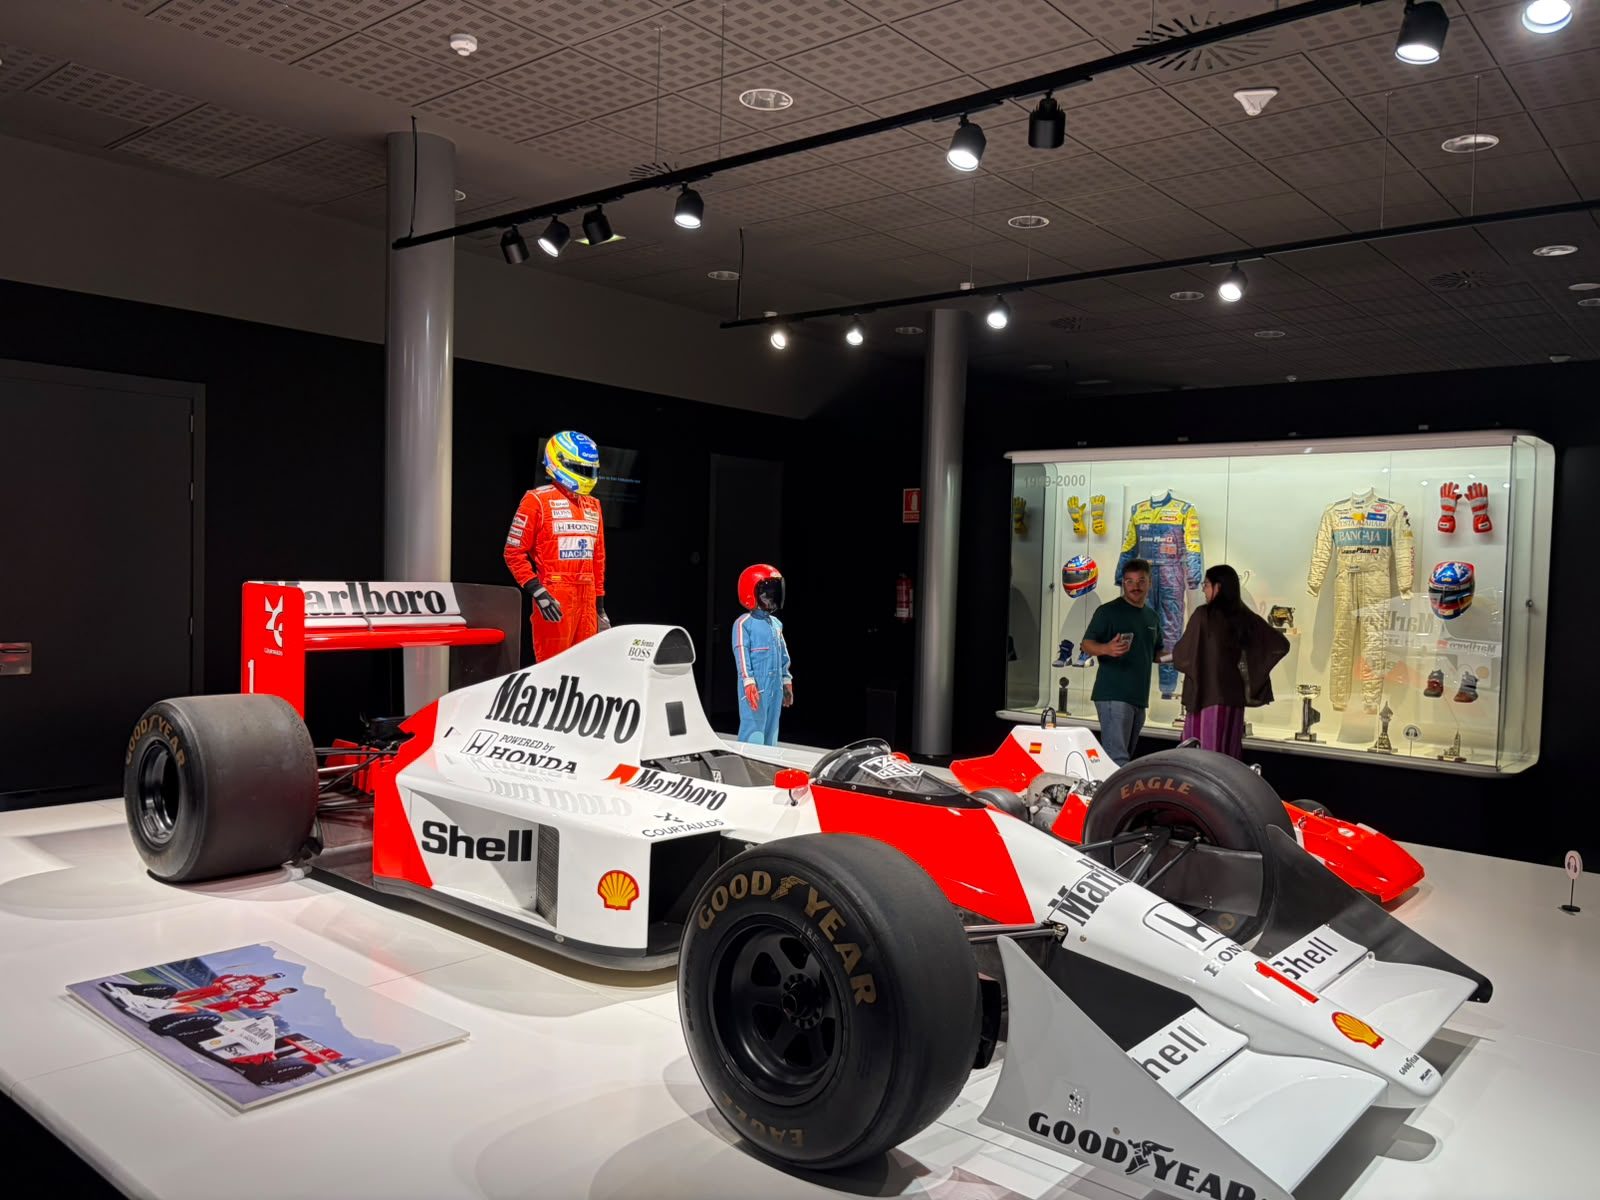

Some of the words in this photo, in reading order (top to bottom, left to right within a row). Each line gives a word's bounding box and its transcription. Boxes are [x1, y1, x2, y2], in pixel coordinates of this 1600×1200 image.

[1339, 529, 1381, 542] BANCAJA
[303, 582, 447, 616] arlboro
[628, 647, 651, 659] BOSS
[485, 672, 641, 745] Marlboro
[486, 745, 578, 775] HONDA
[498, 734, 544, 750] POWERED
[542, 742, 556, 754] by
[627, 768, 728, 811] Marlboro
[1120, 776, 1194, 800] EAGLE
[421, 819, 533, 862] Shell
[641, 818, 724, 838] COURTAULDS
[1271, 936, 1338, 980] Shell
[1254, 960, 1320, 1004] 1
[1131, 1024, 1208, 1081] hell
